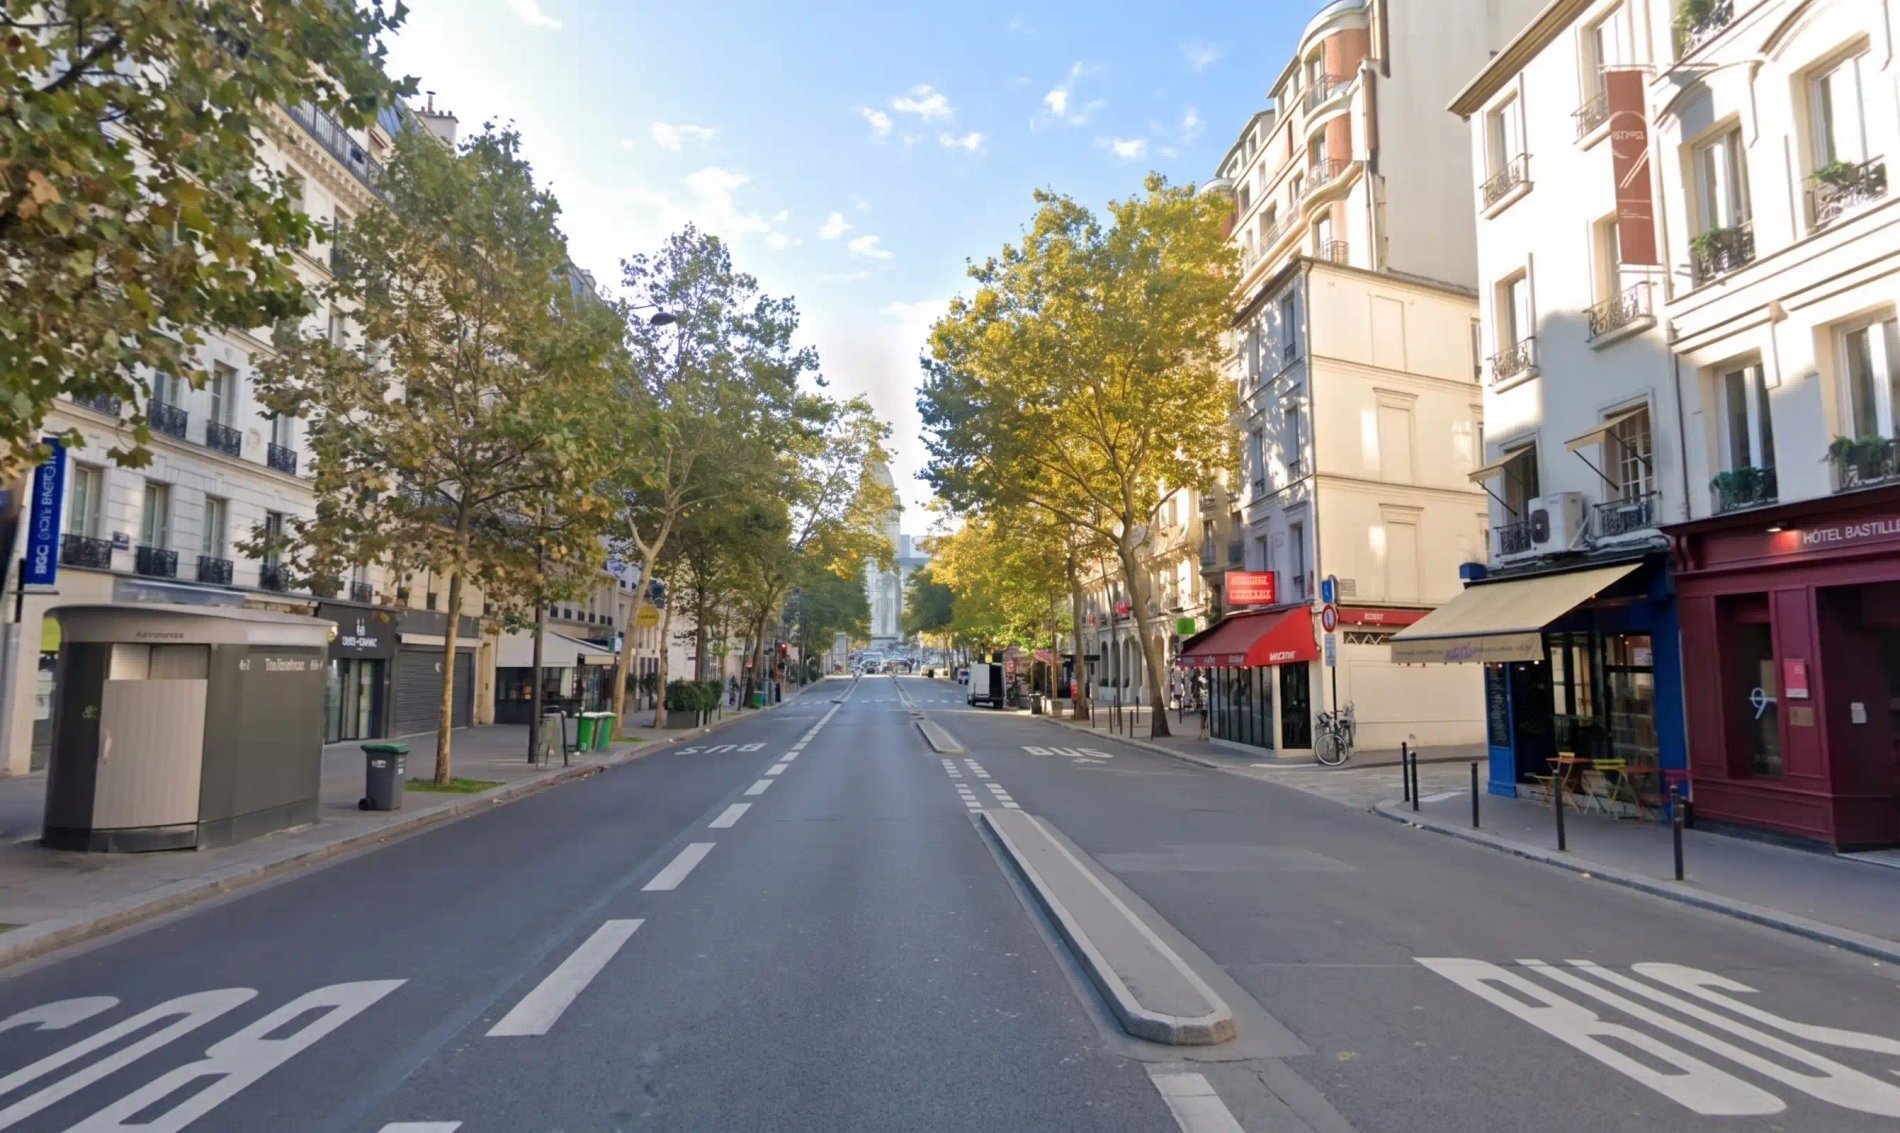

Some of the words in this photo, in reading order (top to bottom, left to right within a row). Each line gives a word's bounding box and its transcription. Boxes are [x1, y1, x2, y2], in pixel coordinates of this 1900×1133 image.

[1803, 528, 1843, 544] HÔTEL
[1021, 746, 1114, 758] BUS
[1413, 957, 1900, 1117] BUS
